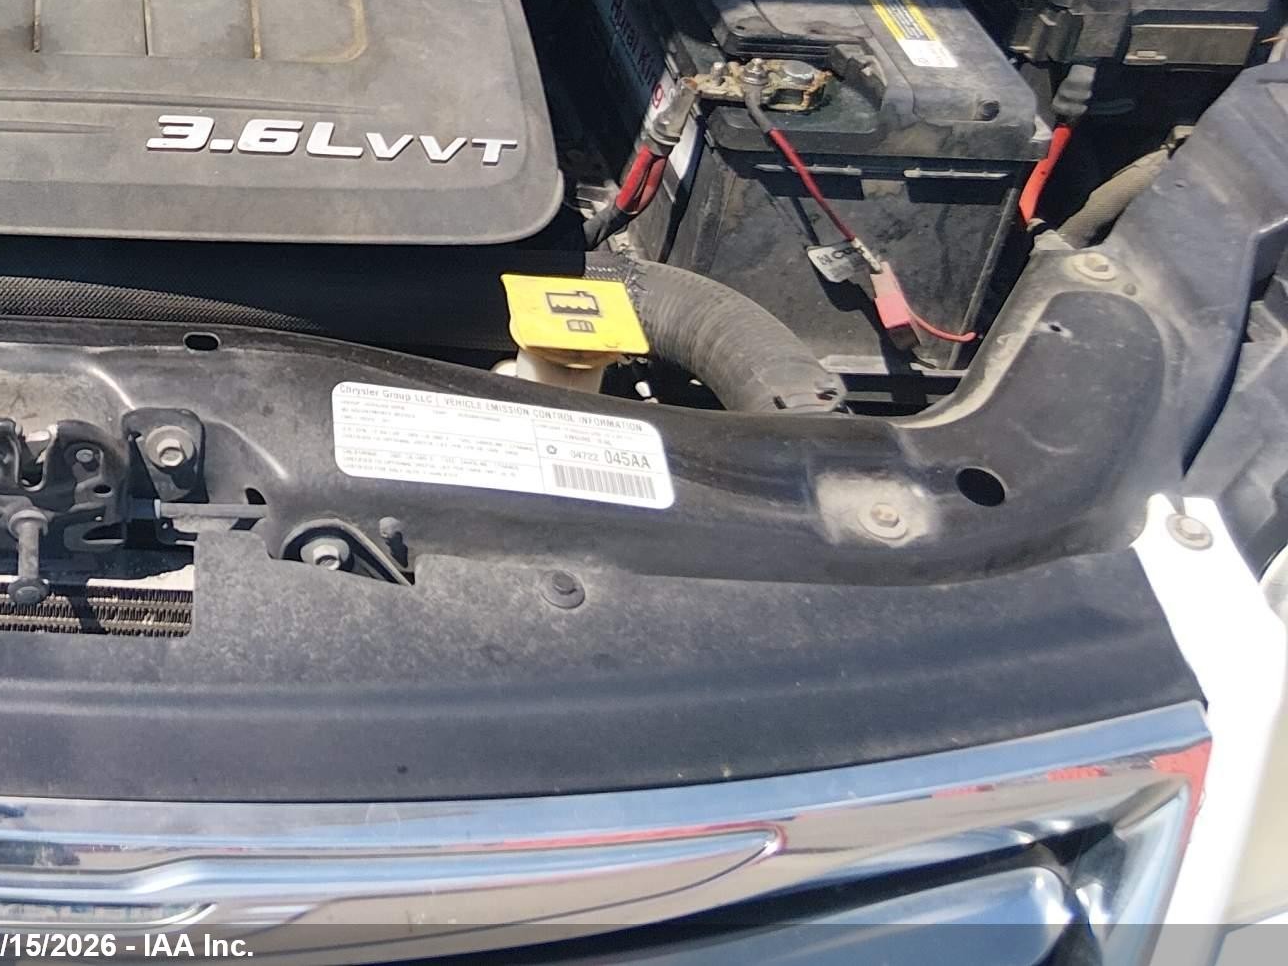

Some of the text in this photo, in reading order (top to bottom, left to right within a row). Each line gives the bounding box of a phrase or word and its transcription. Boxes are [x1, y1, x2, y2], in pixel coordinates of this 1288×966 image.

[146, 115, 518, 165] 3.6L VVT
[339, 384, 380, 397] Chrysler
[382, 389, 412, 403] Group
[414, 393, 434, 404] LLC
[443, 397, 483, 411] VEHICLE
[485, 401, 530, 416] EMISSION
[532, 407, 576, 423] CONTROL
[578, 415, 643, 432] INFORMATION
